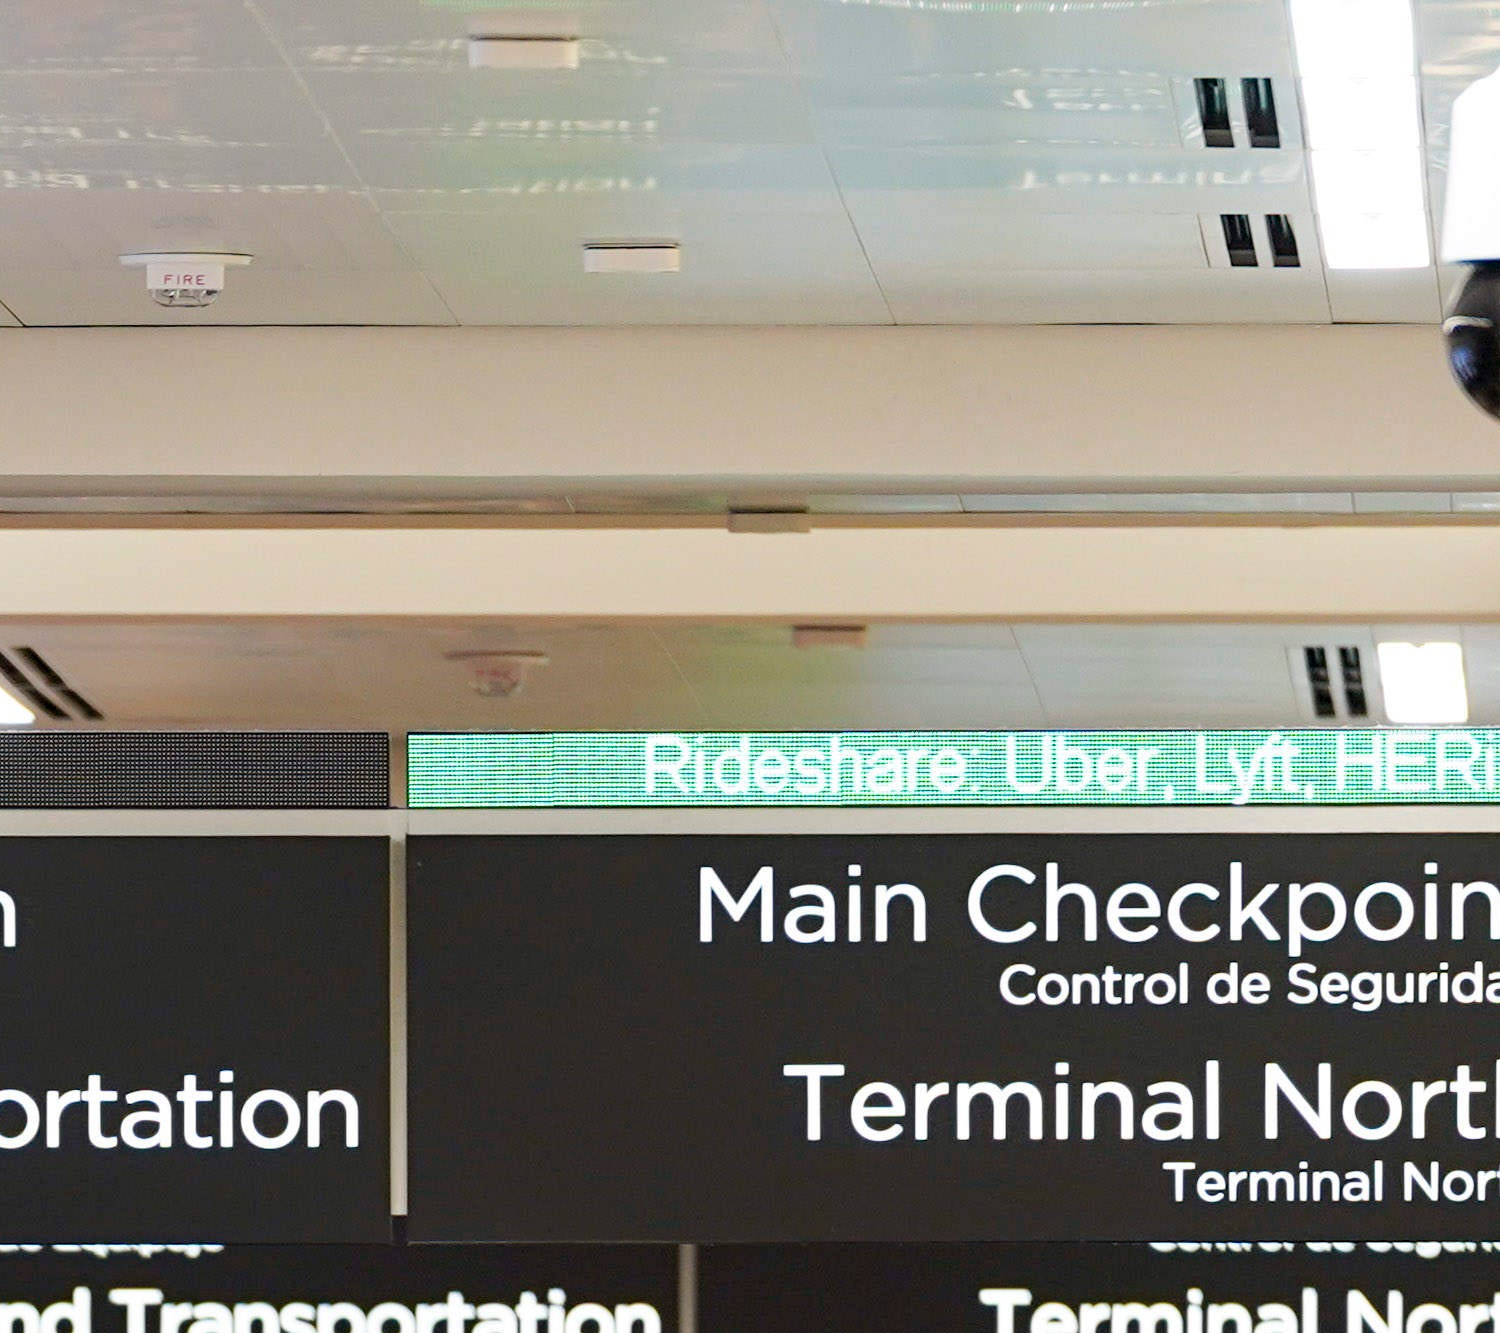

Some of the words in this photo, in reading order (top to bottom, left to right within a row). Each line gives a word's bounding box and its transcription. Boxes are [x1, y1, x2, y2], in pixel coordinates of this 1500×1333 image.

[163, 274, 206, 286] FIRE
[645, 733, 980, 795] Rideshare:
[1005, 733, 1174, 801] Uber,
[1195, 733, 1314, 805] Lyft,
[700, 865, 926, 943] Main
[1000, 961, 1188, 1005] Control
[1207, 961, 1270, 1005] de
[783, 1060, 1219, 1141] Terminal
[1163, 1160, 1383, 1203] Terminal
